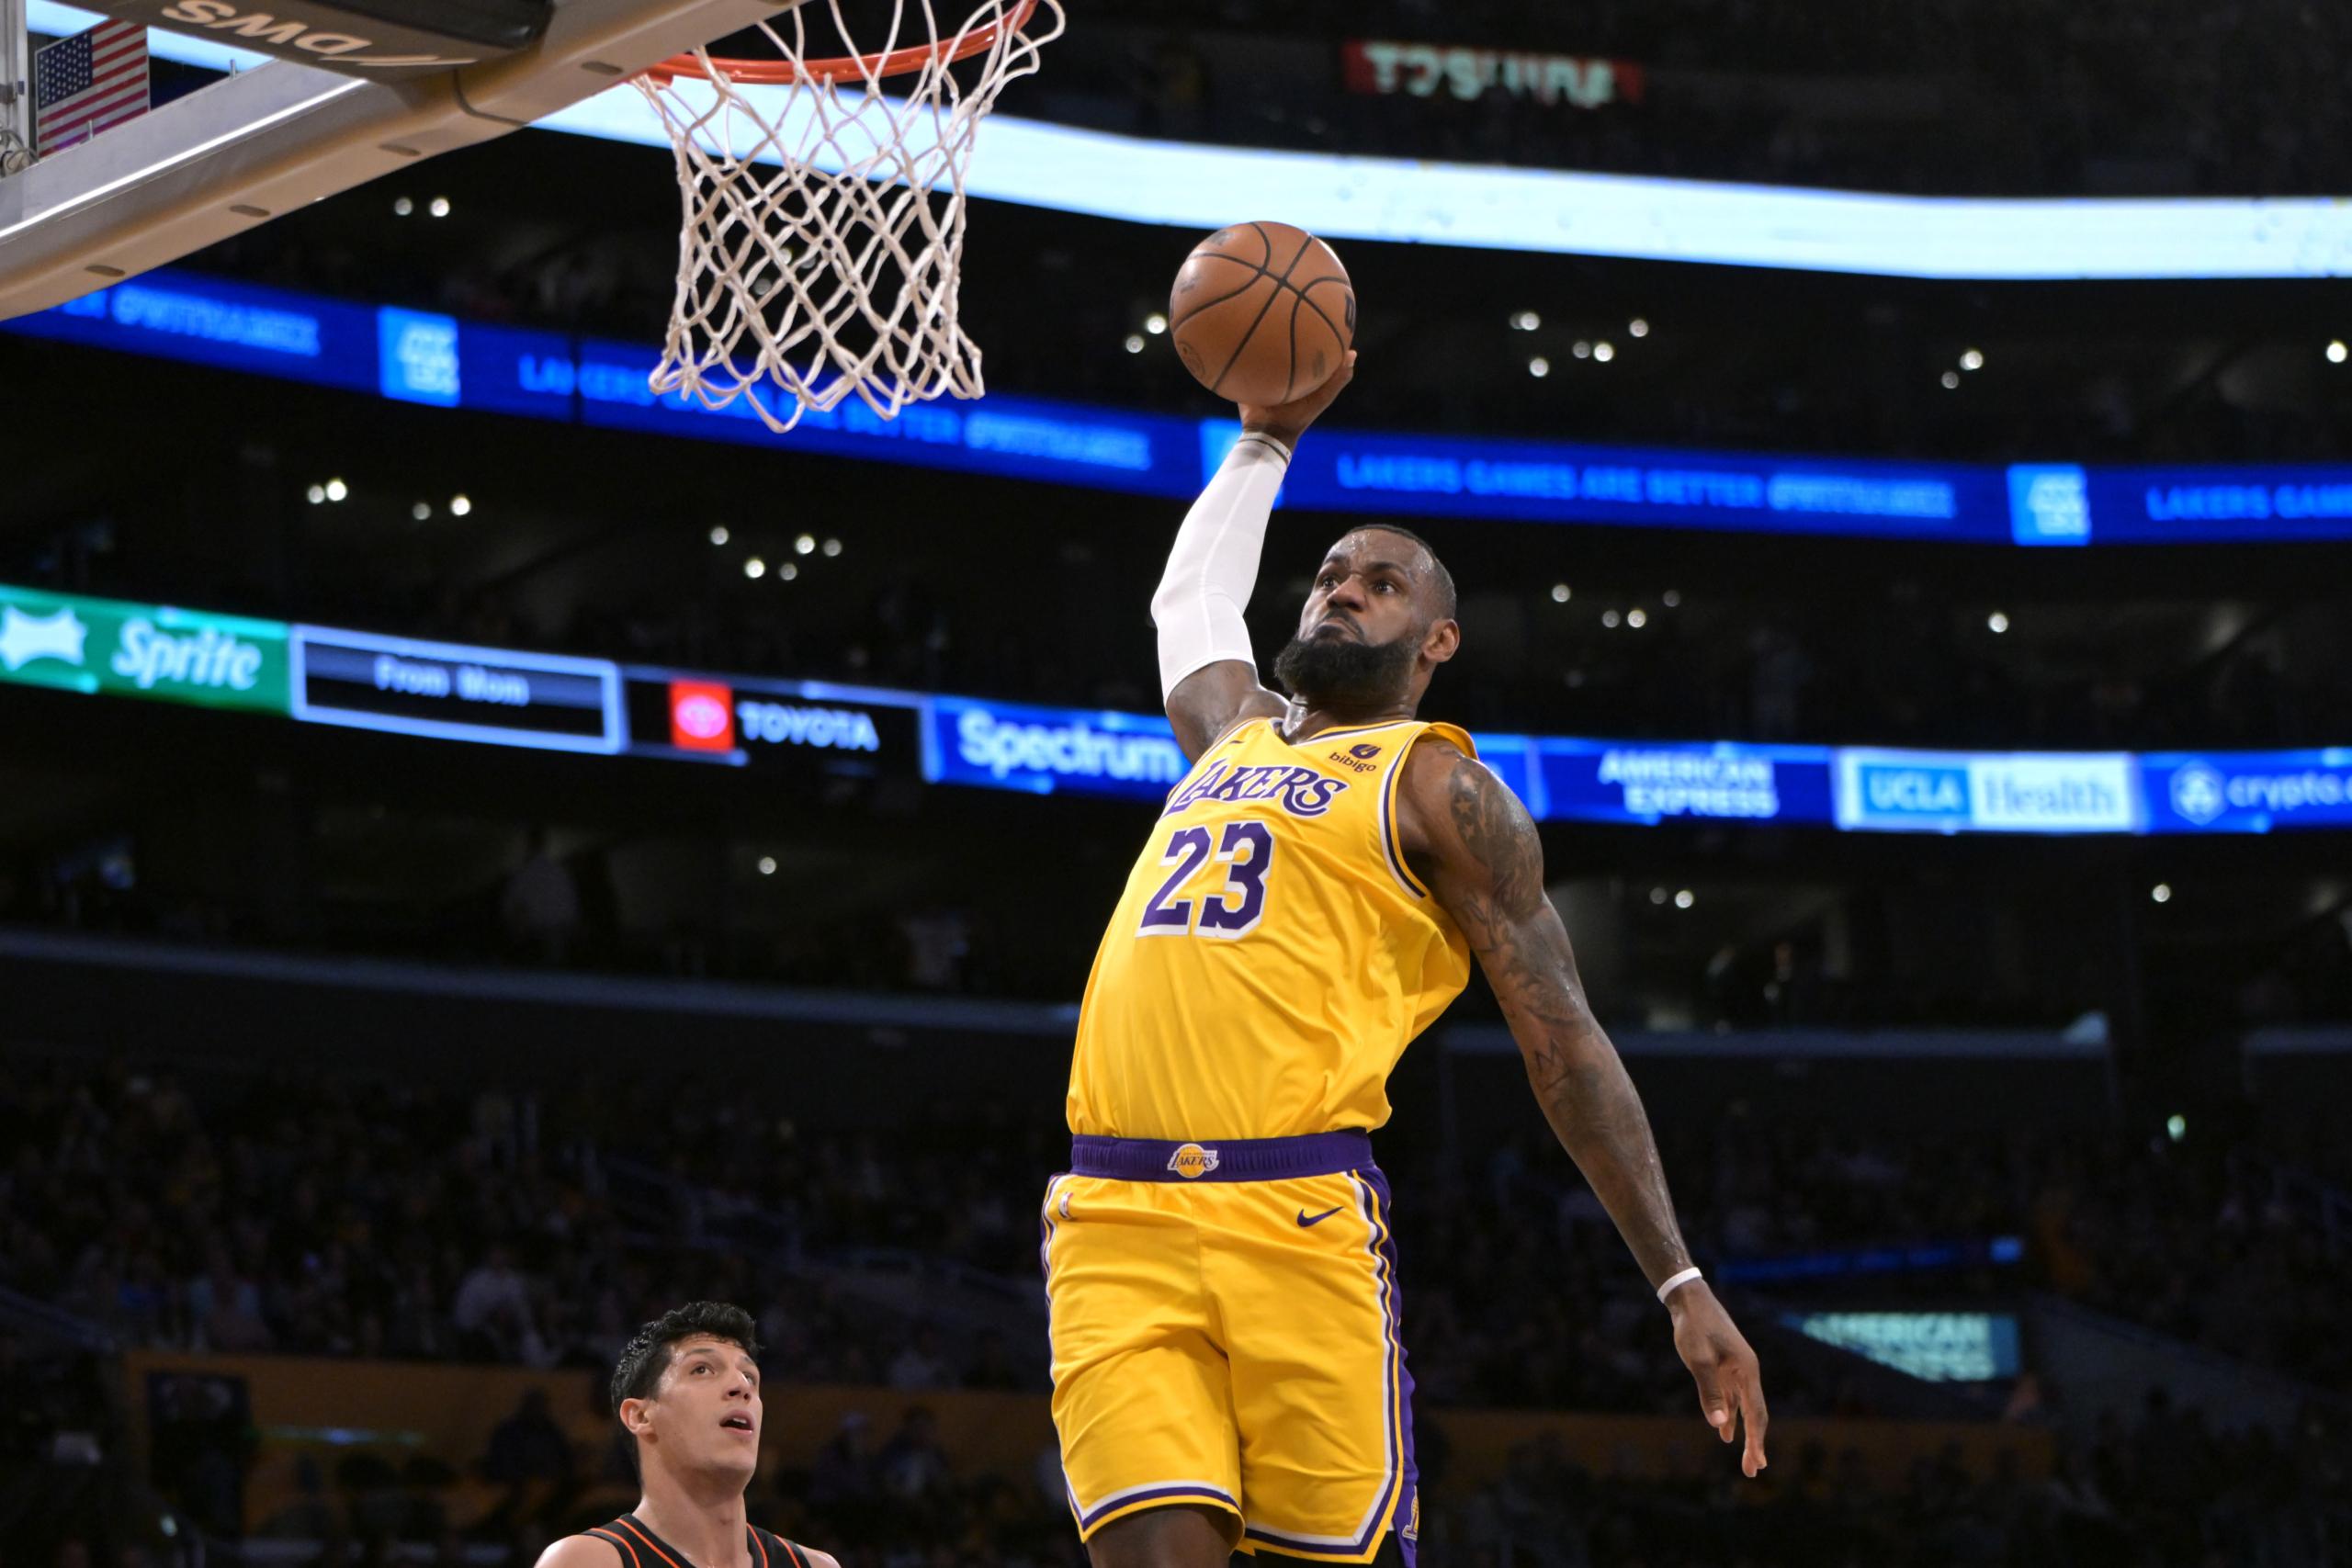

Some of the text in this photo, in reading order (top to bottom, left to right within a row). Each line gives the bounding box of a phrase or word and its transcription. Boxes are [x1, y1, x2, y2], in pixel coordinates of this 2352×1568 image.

[161, 0, 372, 55] DWS
[110, 616, 263, 691] Sprite
[738, 701, 879, 751] TOYOTA
[957, 707, 1182, 781] Spectrum
[1163, 757, 1350, 817] LAKERS
[1329, 751, 1377, 773] bibigo
[1599, 749, 1774, 784] AMERICAN
[1623, 785, 1780, 818] EXPRESS
[1868, 770, 2116, 817] UCLA Health
[1136, 819, 1275, 940] 23
